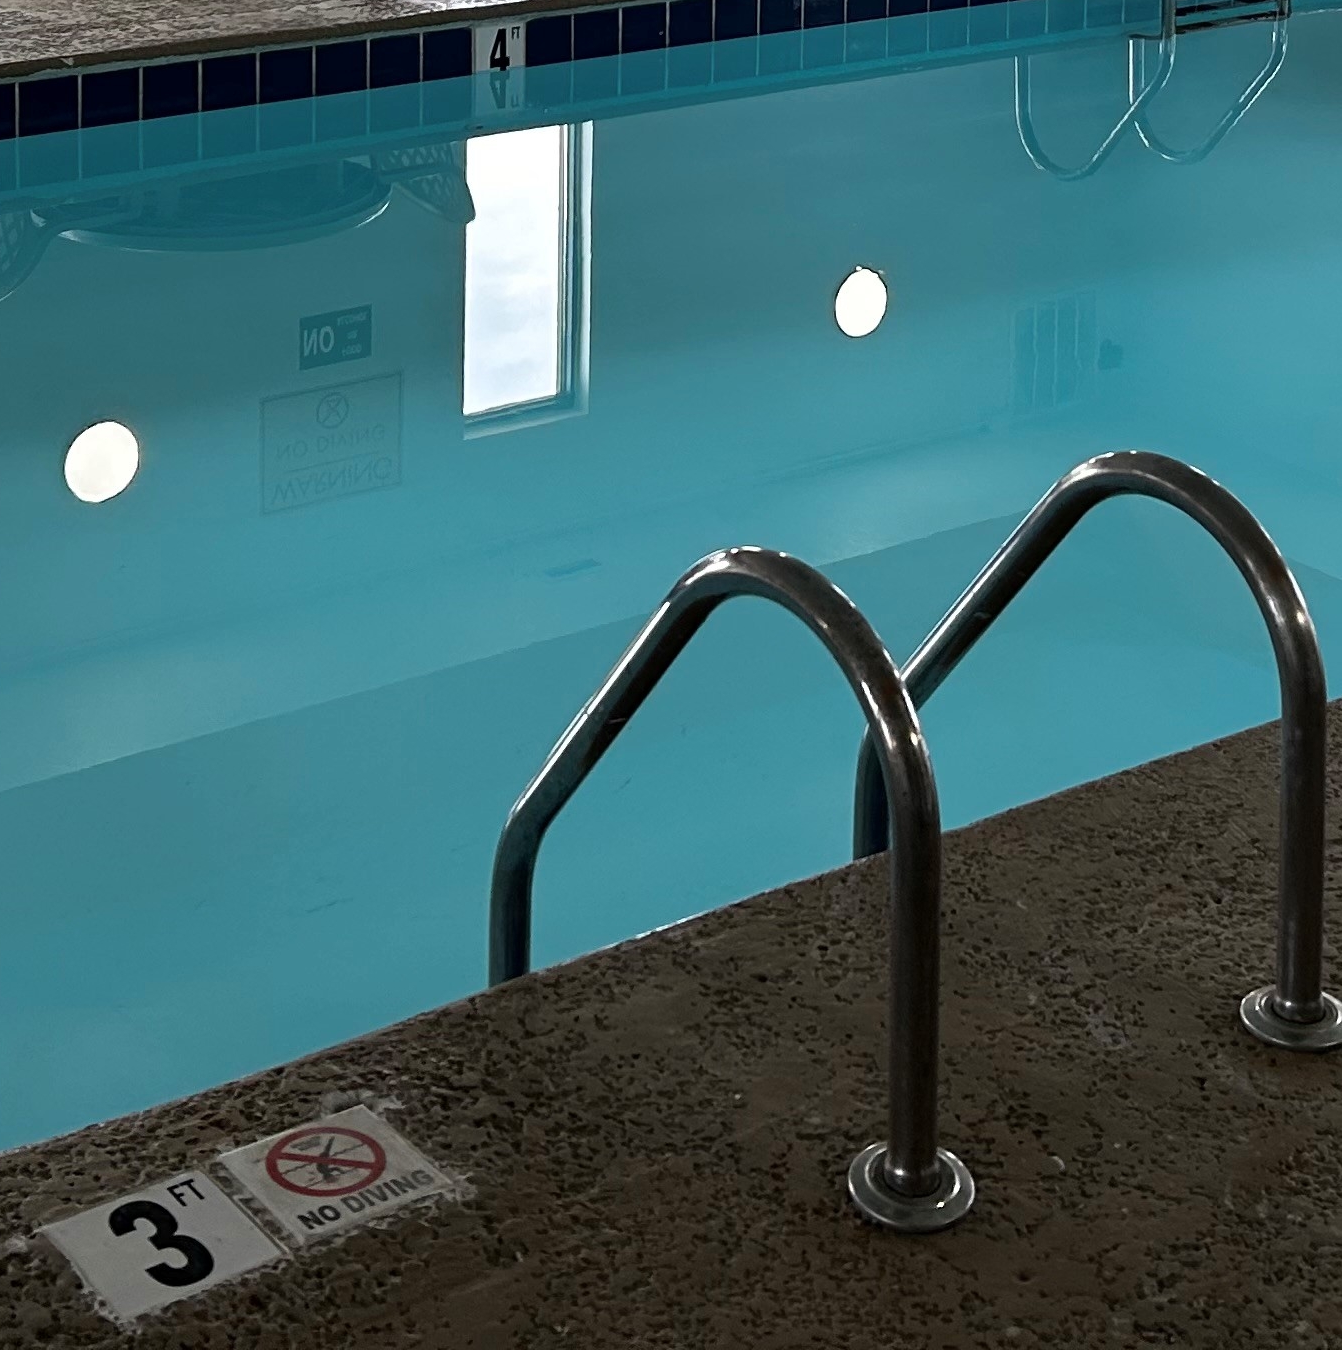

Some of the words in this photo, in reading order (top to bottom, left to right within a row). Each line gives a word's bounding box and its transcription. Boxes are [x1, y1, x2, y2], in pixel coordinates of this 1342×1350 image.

[490, 28, 510, 71] 4
[511, 26, 521, 40] FT
[297, 1205, 342, 1230] NO
[340, 1169, 434, 1213] DIVING
[108, 1200, 215, 1287] 3
[166, 1178, 206, 1207] FT
